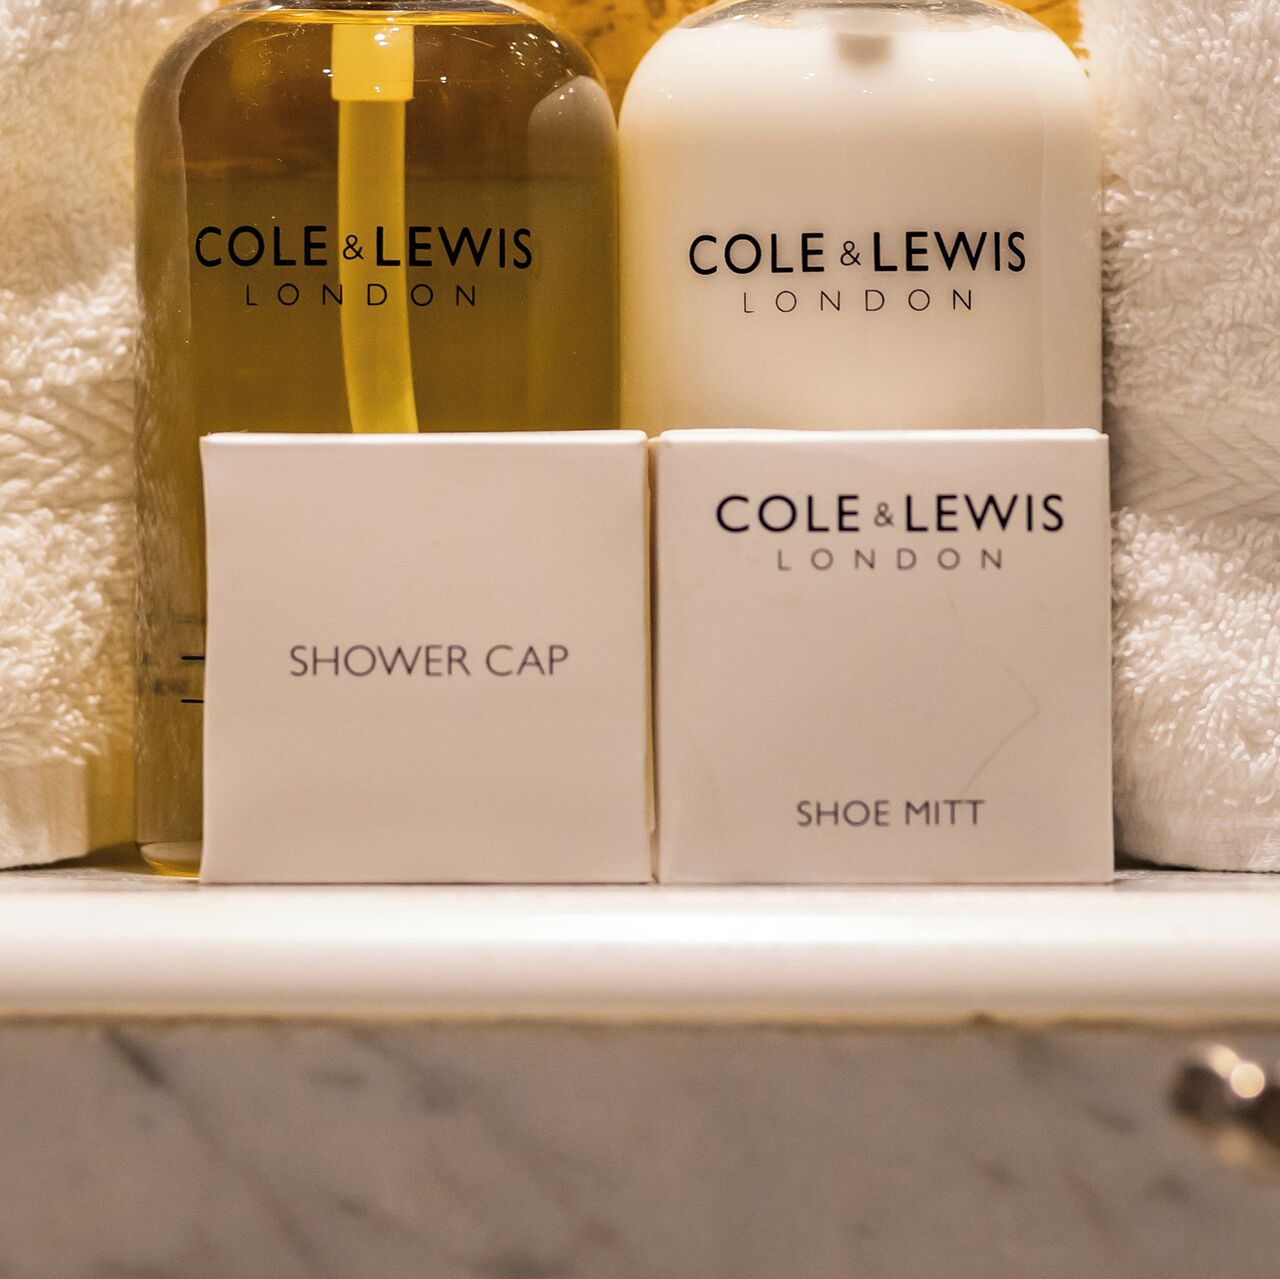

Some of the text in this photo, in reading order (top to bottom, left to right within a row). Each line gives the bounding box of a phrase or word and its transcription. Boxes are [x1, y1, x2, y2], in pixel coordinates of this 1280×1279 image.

[195, 226, 329, 269] COLE
[376, 226, 534, 271] LEWIS
[689, 233, 826, 277] COLE
[874, 232, 1027, 274] LEWIS
[246, 282, 477, 308] LONDON
[743, 289, 973, 315] LONDON
[716, 495, 861, 535] COLE
[906, 494, 1065, 534] LEWIS
[778, 547, 1004, 573] LONDON
[290, 645, 570, 679] SHOWER CAP
[797, 800, 987, 829] SHOE MITT
